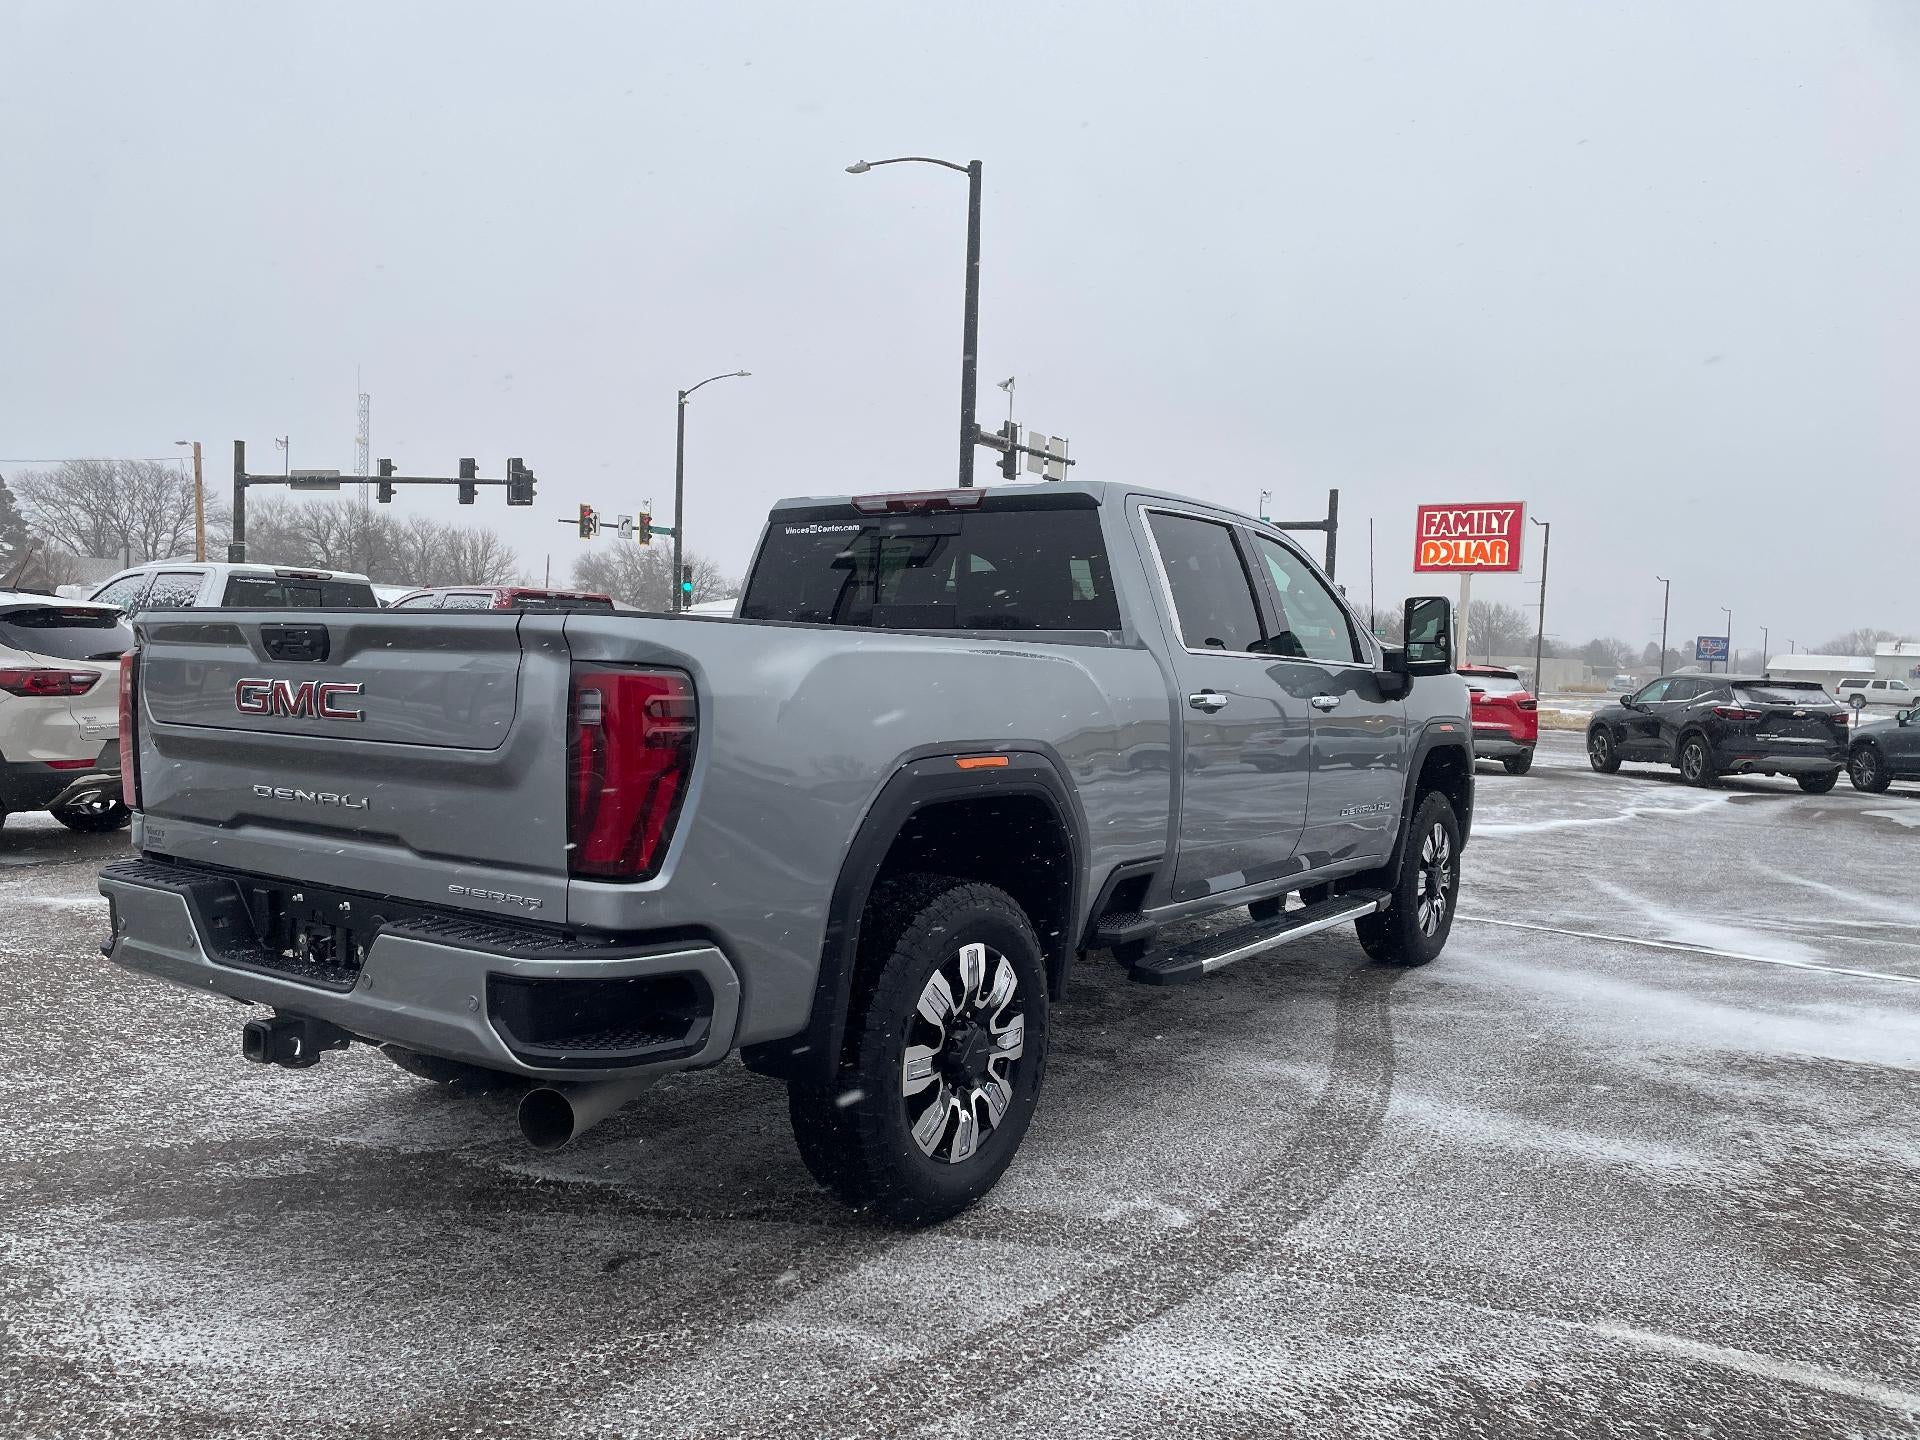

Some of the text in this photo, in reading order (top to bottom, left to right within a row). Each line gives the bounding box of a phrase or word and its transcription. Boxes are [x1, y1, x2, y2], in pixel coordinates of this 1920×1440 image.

[1423, 509, 1515, 537] FAMILY
[1421, 538, 1509, 566] DOLLAR
[235, 678, 365, 722] GMC
[253, 784, 370, 811] DENALI
[448, 884, 543, 908] SIERRA
